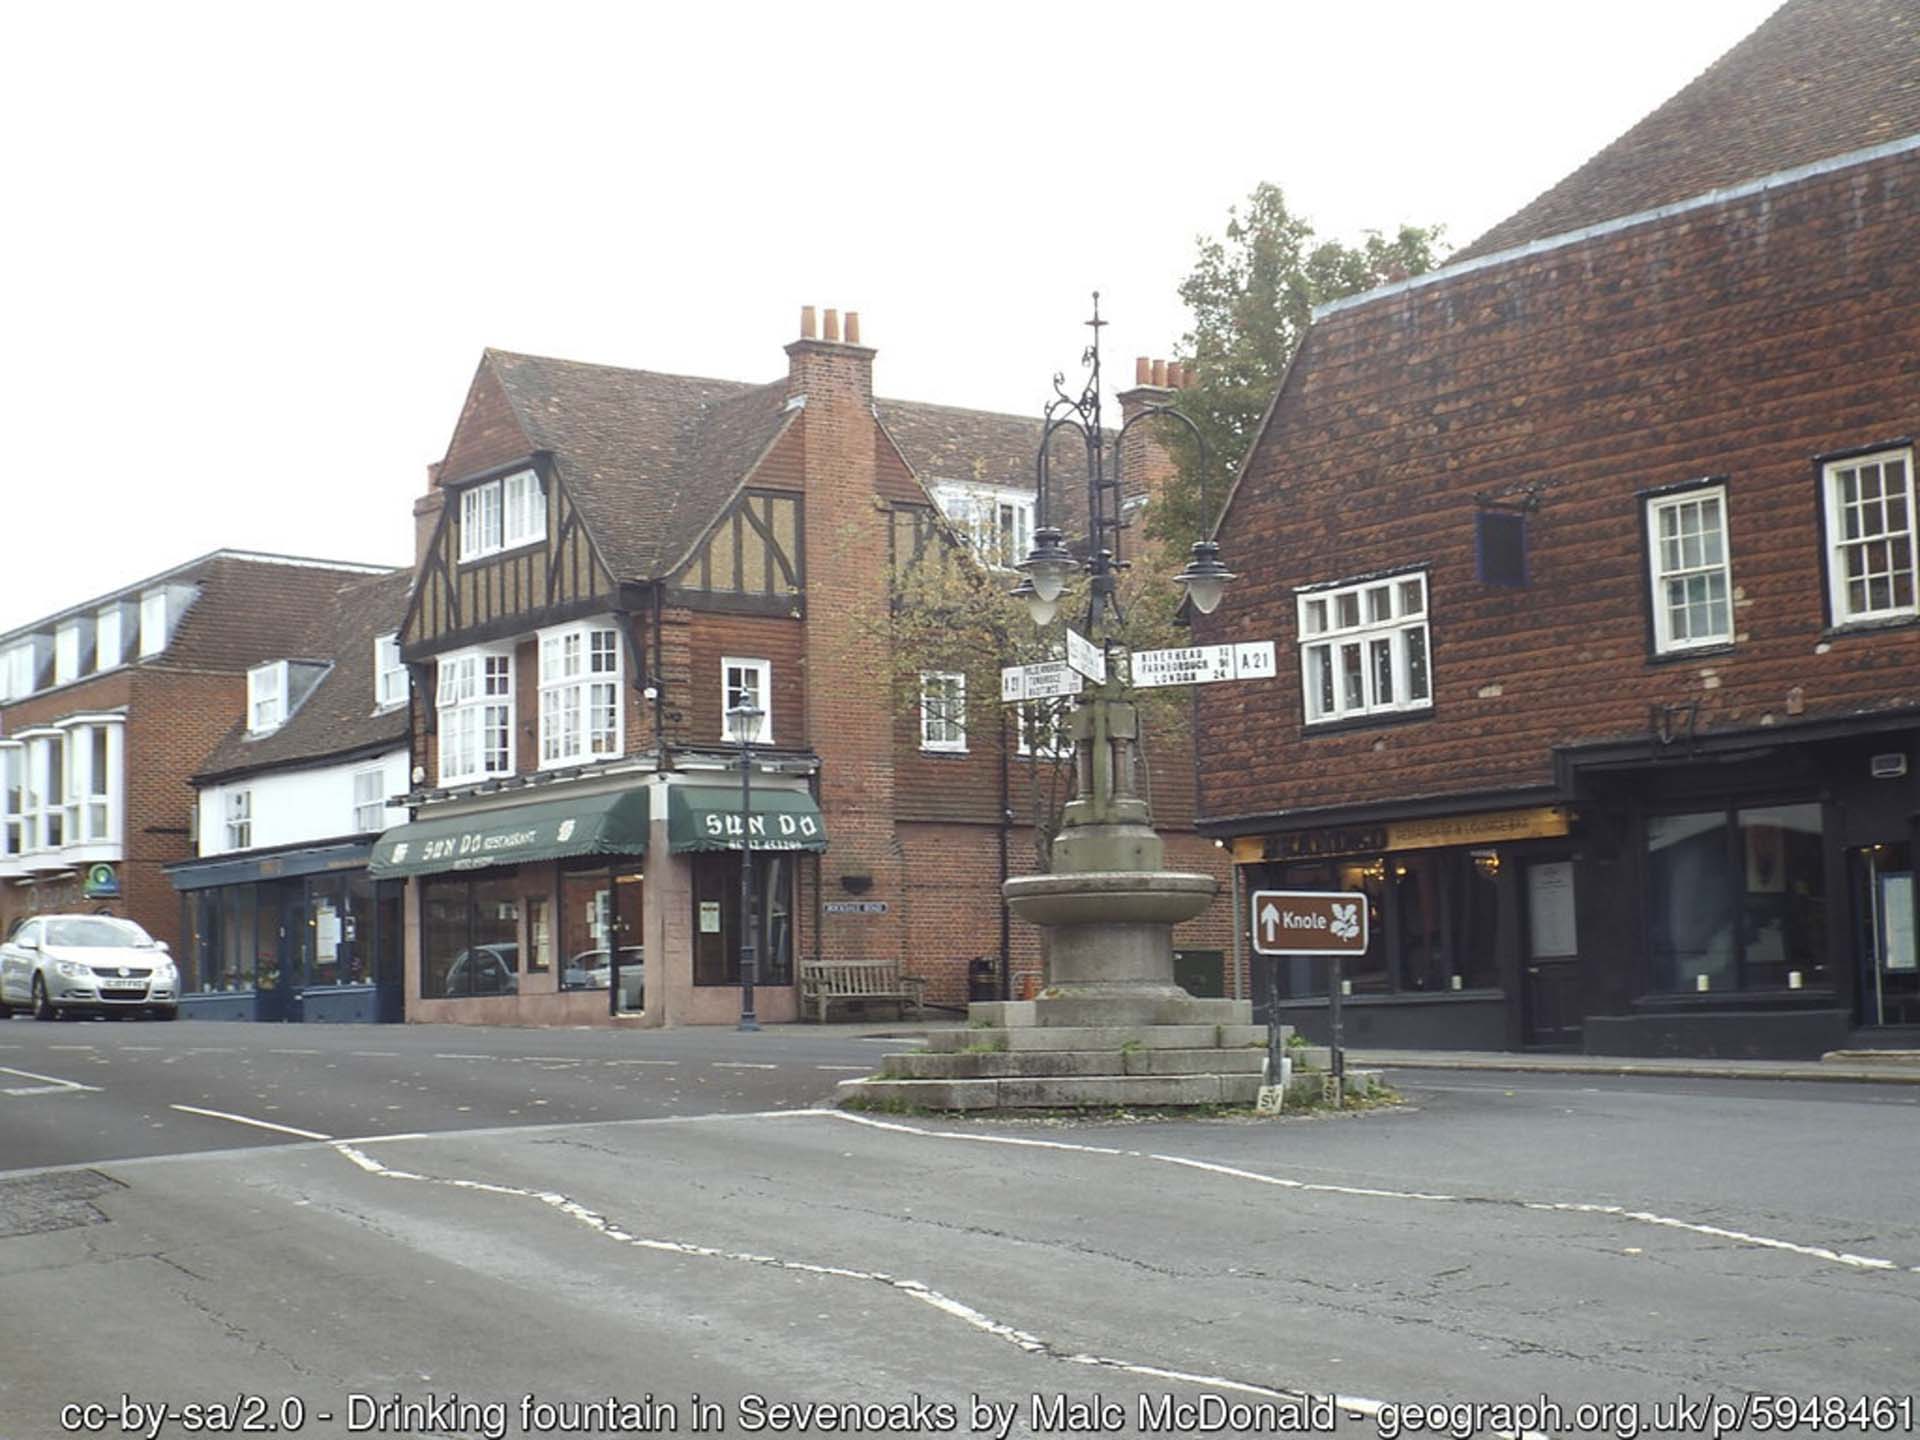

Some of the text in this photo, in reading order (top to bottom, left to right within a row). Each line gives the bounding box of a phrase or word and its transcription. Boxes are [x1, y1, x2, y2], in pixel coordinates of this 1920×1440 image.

[1154, 671, 1196, 684] LONDON
[705, 813, 817, 836] SUN DO
[422, 838, 456, 861] SUN
[460, 834, 481, 855] DO
[1282, 911, 1327, 929] Knole
